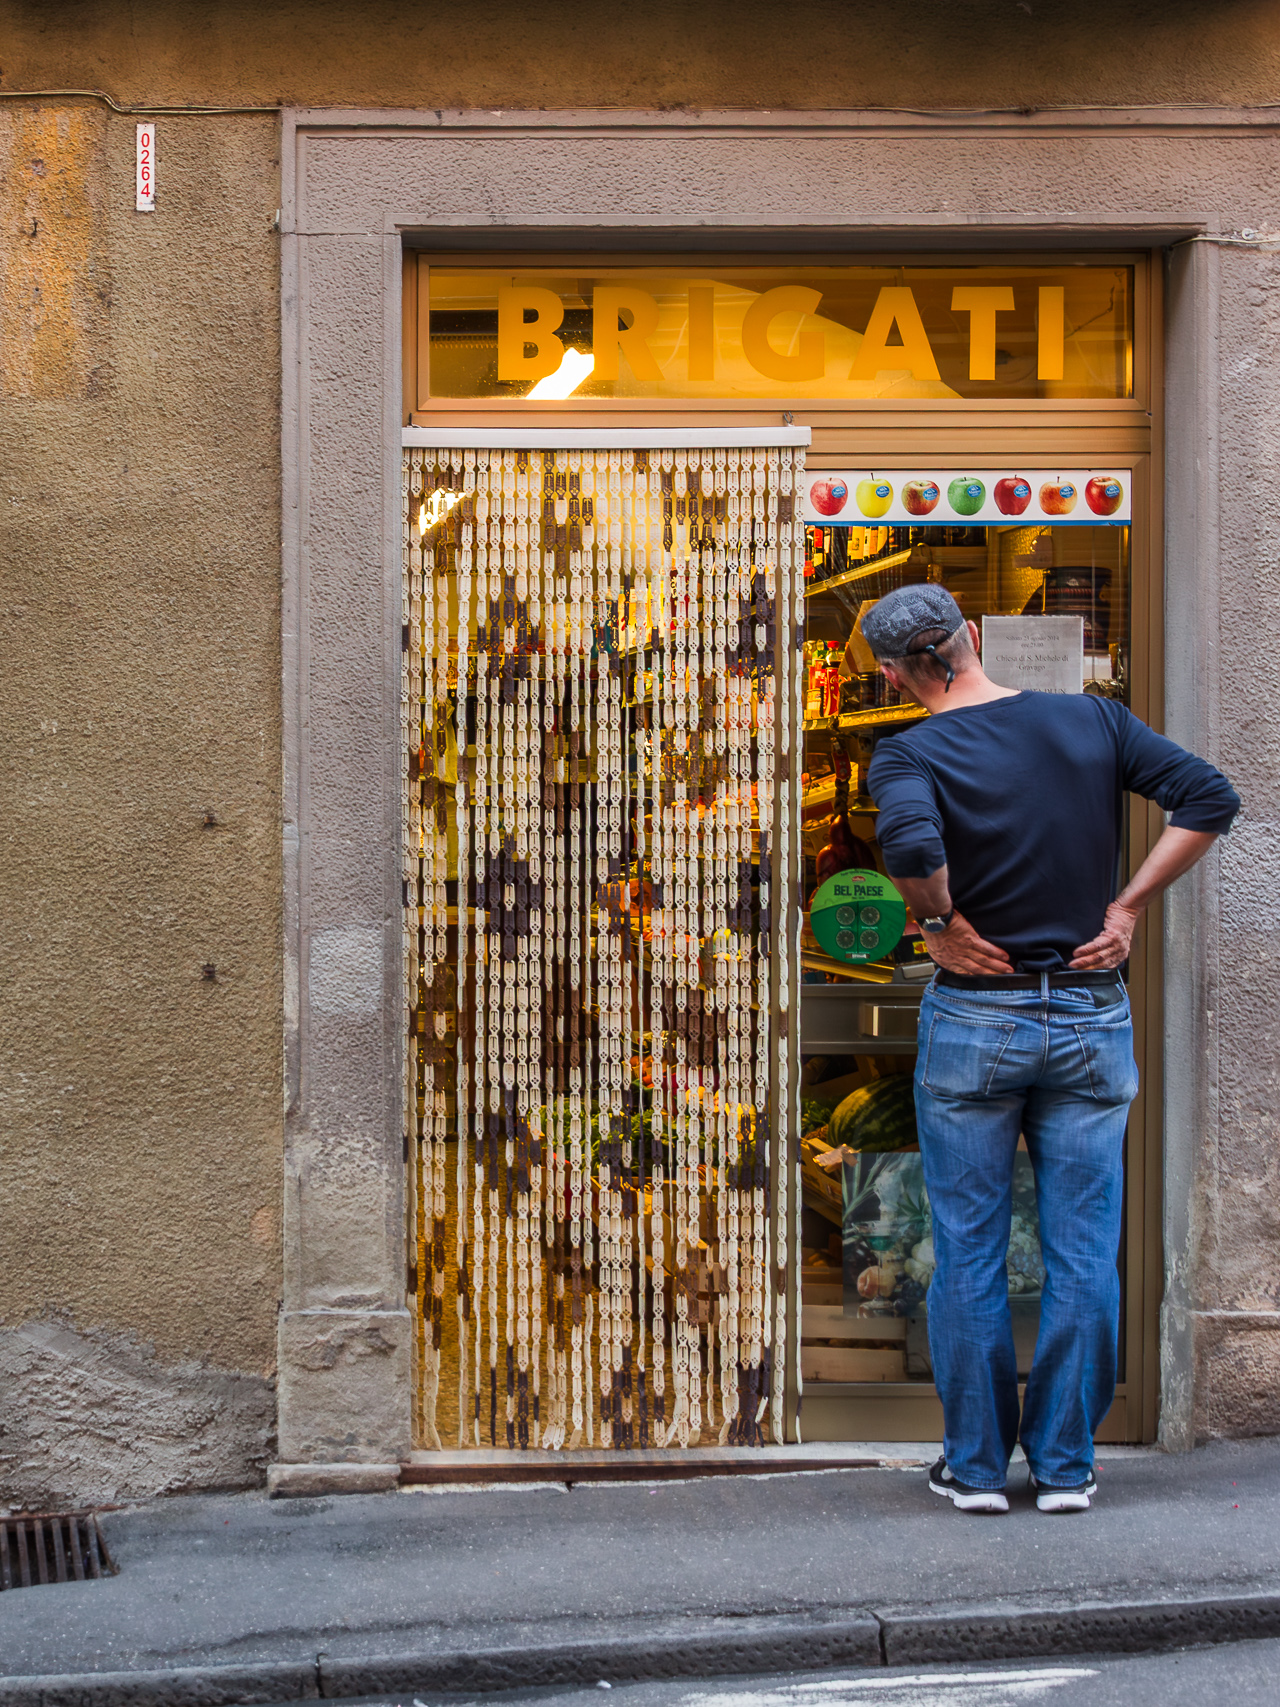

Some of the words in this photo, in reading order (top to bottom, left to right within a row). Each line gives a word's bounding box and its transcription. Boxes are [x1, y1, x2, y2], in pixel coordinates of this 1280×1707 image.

[140, 132, 151, 198] 0264
[497, 285, 1064, 381] BRIGATI
[833, 884, 852, 896] BEL
[854, 884, 883, 896] PAESE
